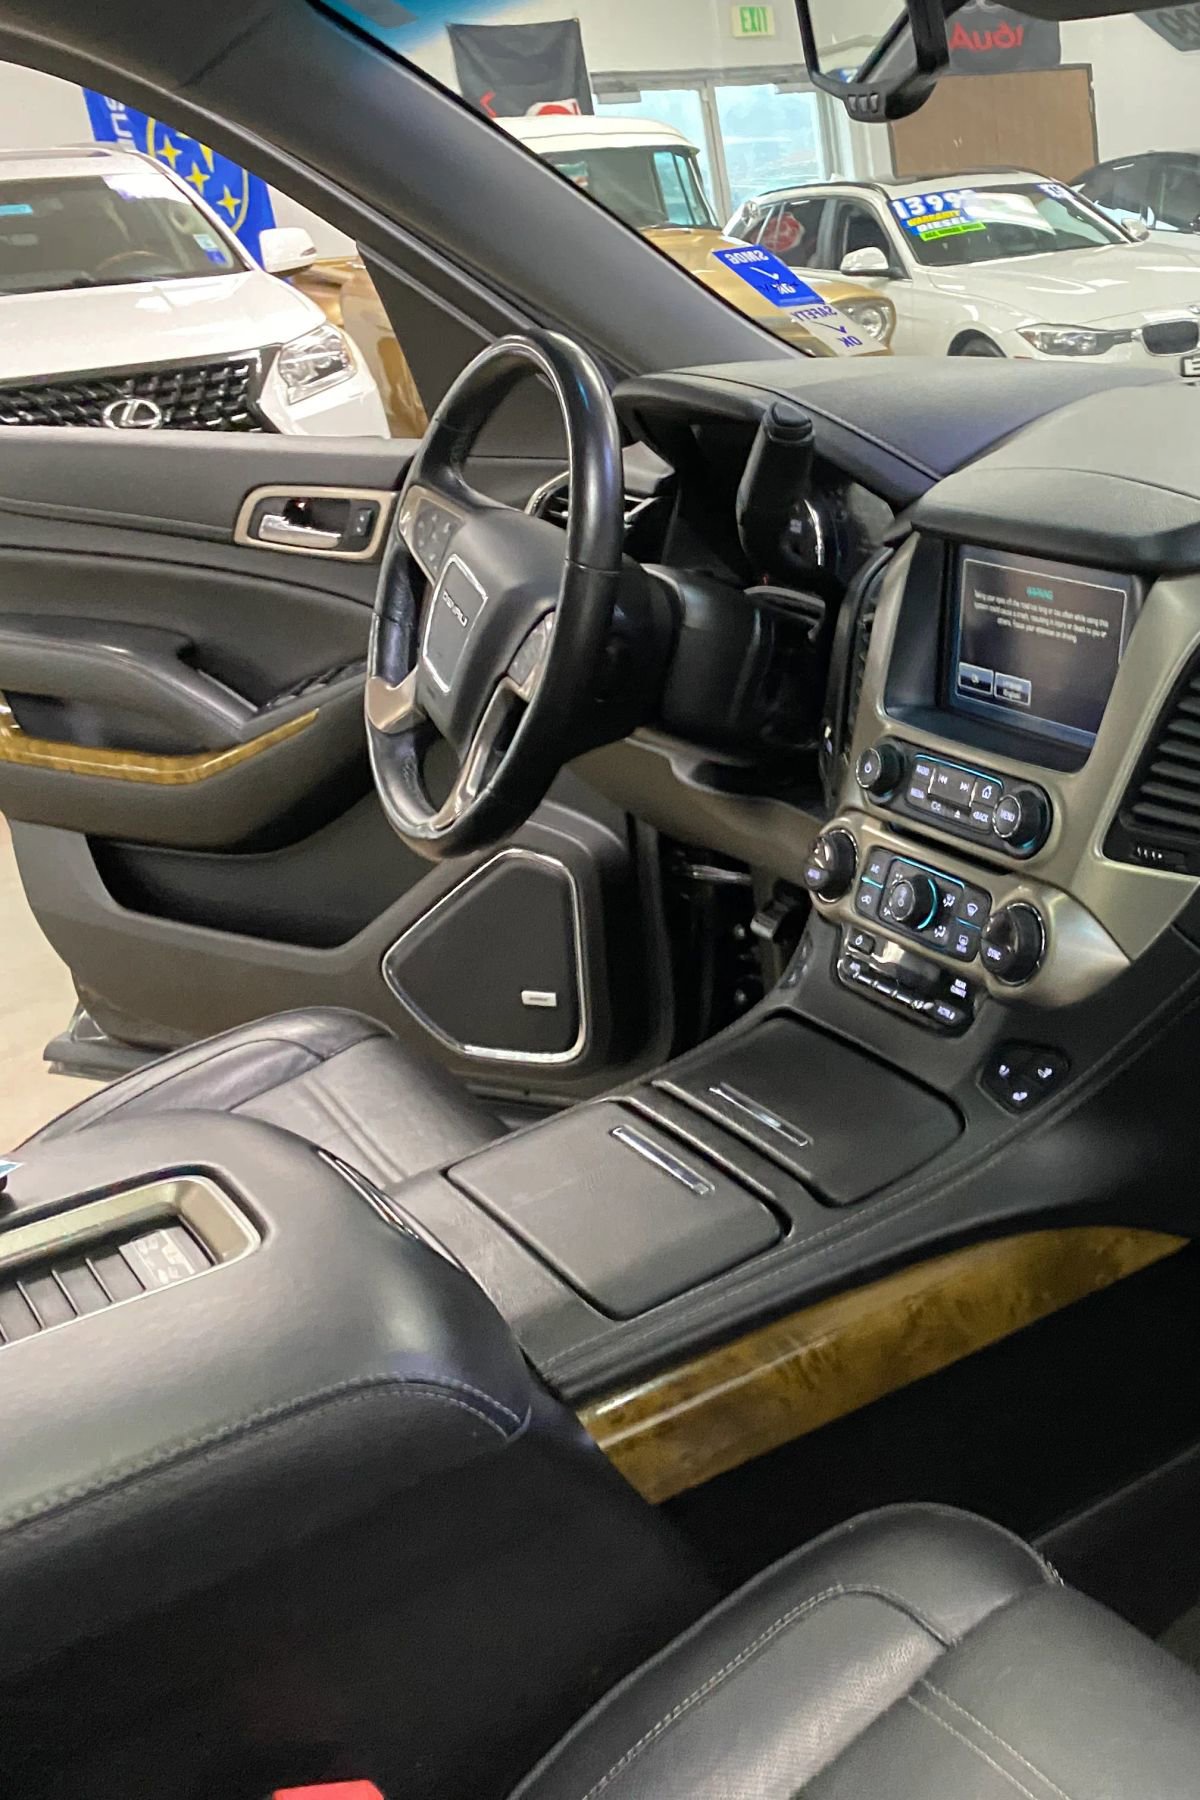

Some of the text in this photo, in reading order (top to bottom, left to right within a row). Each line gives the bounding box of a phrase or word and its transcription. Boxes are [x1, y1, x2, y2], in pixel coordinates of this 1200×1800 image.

[740, 7, 768, 33] EXIT
[949, 20, 1025, 50] Audi
[917, 216, 971, 232] DIESEL
